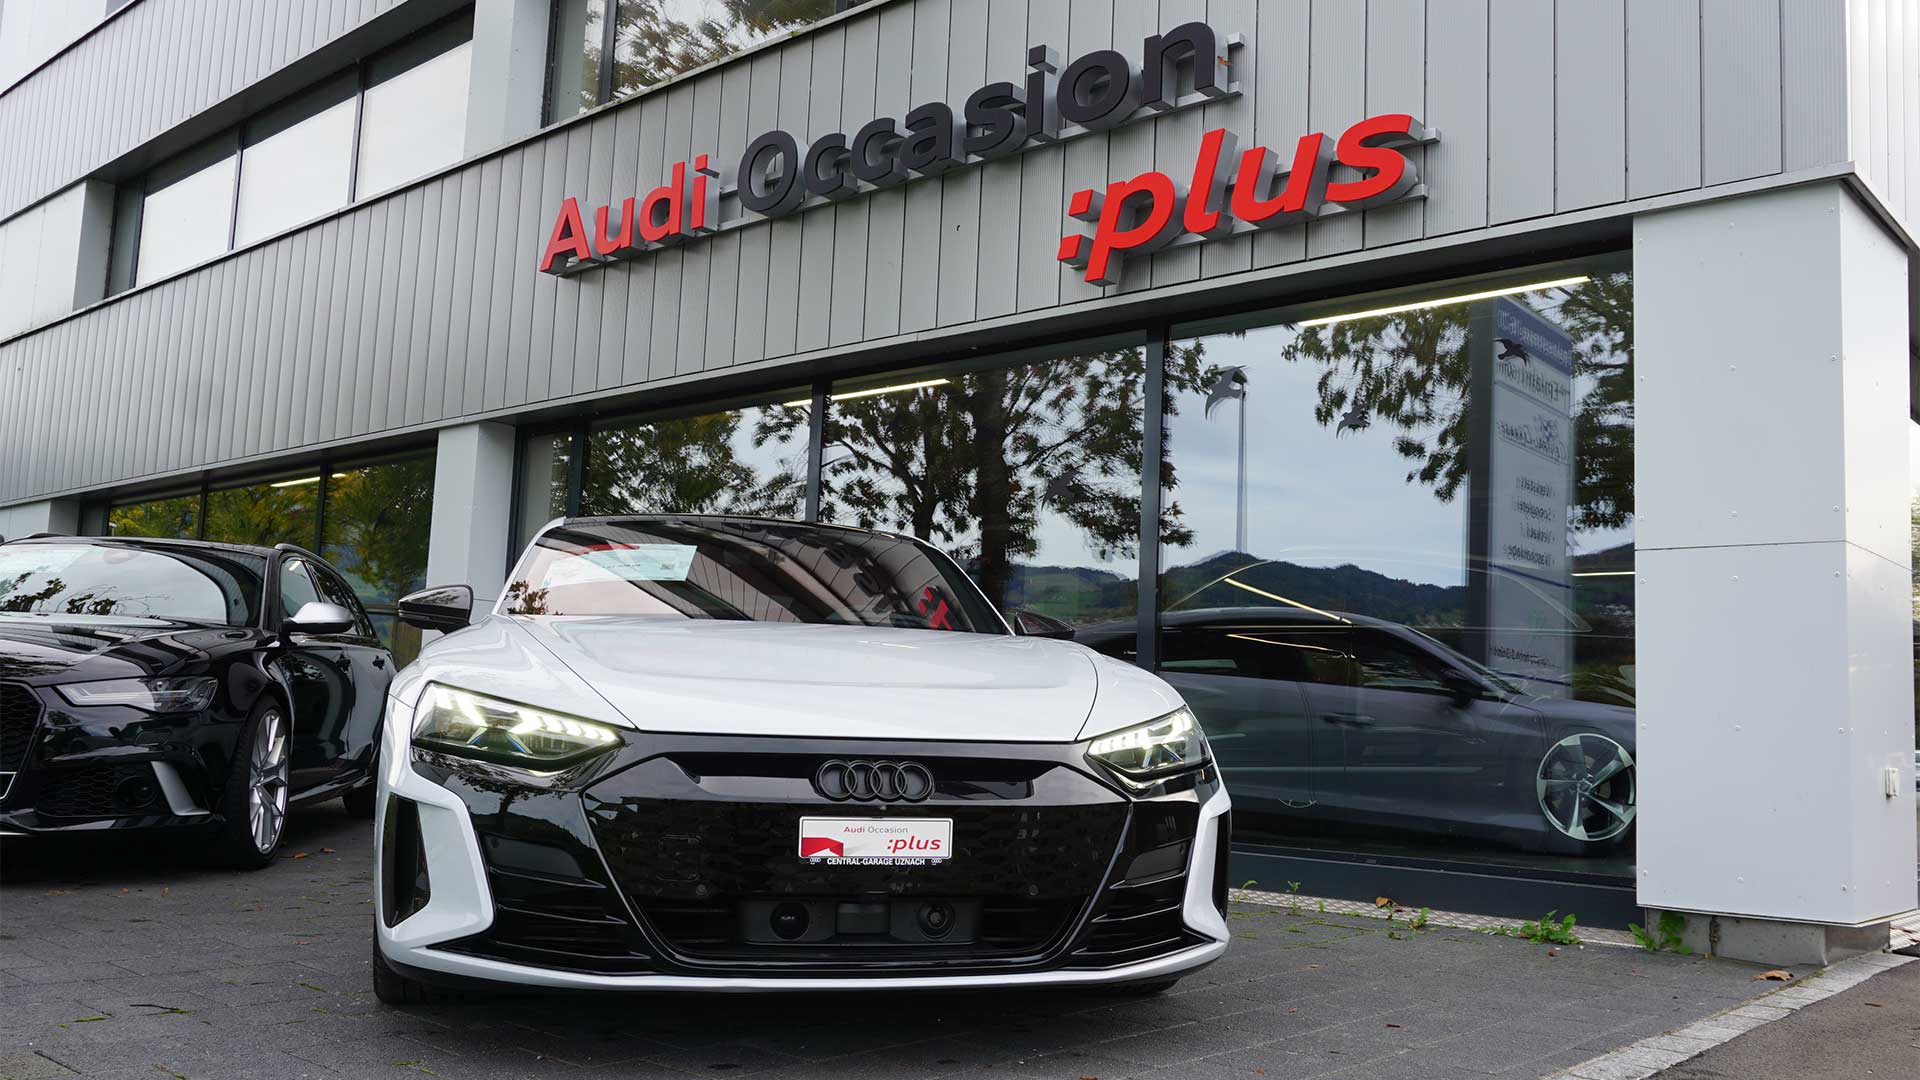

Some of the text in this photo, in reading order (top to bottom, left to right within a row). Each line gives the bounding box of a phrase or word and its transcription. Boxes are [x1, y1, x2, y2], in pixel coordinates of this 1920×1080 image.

[540, 21, 1218, 273] Audi Occasion
[1057, 113, 1416, 284] :plus
[867, 826, 909, 834] Occasion
[887, 835, 942, 854] :plus
[826, 858, 894, 866] CENTRAL-GARAGE
[894, 858, 926, 866] UZNACH
